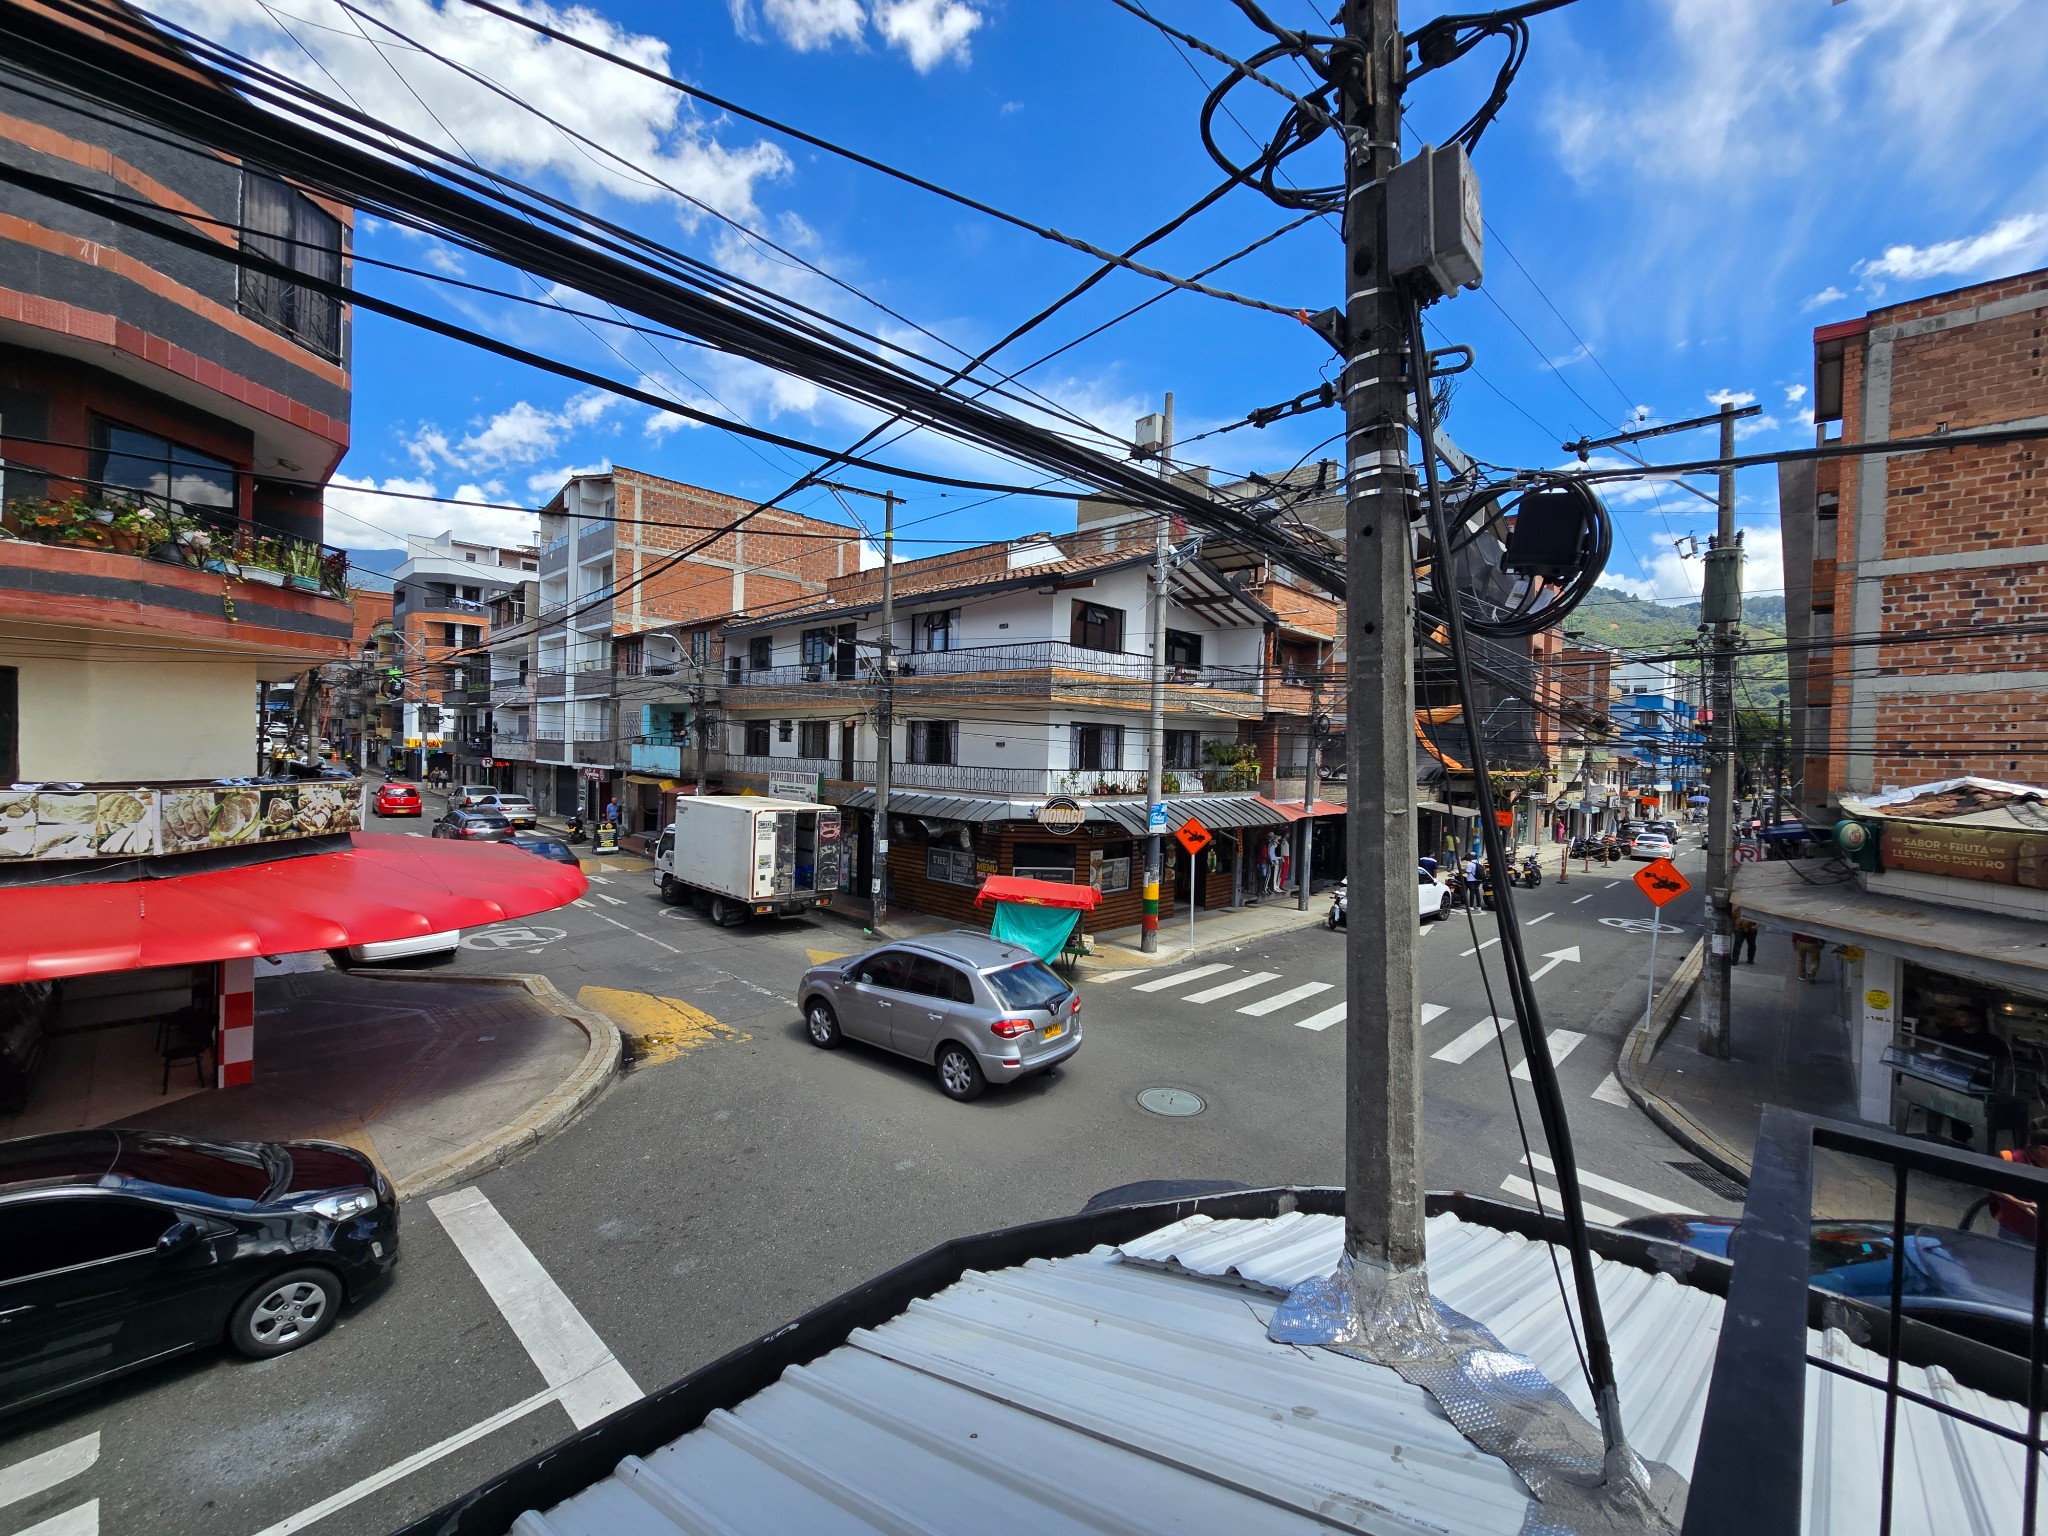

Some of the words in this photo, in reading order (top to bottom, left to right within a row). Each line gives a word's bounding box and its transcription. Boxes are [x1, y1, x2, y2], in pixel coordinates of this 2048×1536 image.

[1038, 808, 1086, 823] MONACO
[1904, 837, 1941, 850] SABOR
[1950, 842, 1989, 855] FRUTA
[932, 855, 948, 866] THE
[1892, 848, 1950, 863] LLEVAMOS
[1953, 855, 2006, 870] DENTRO
[976, 862, 998, 873] MENU
